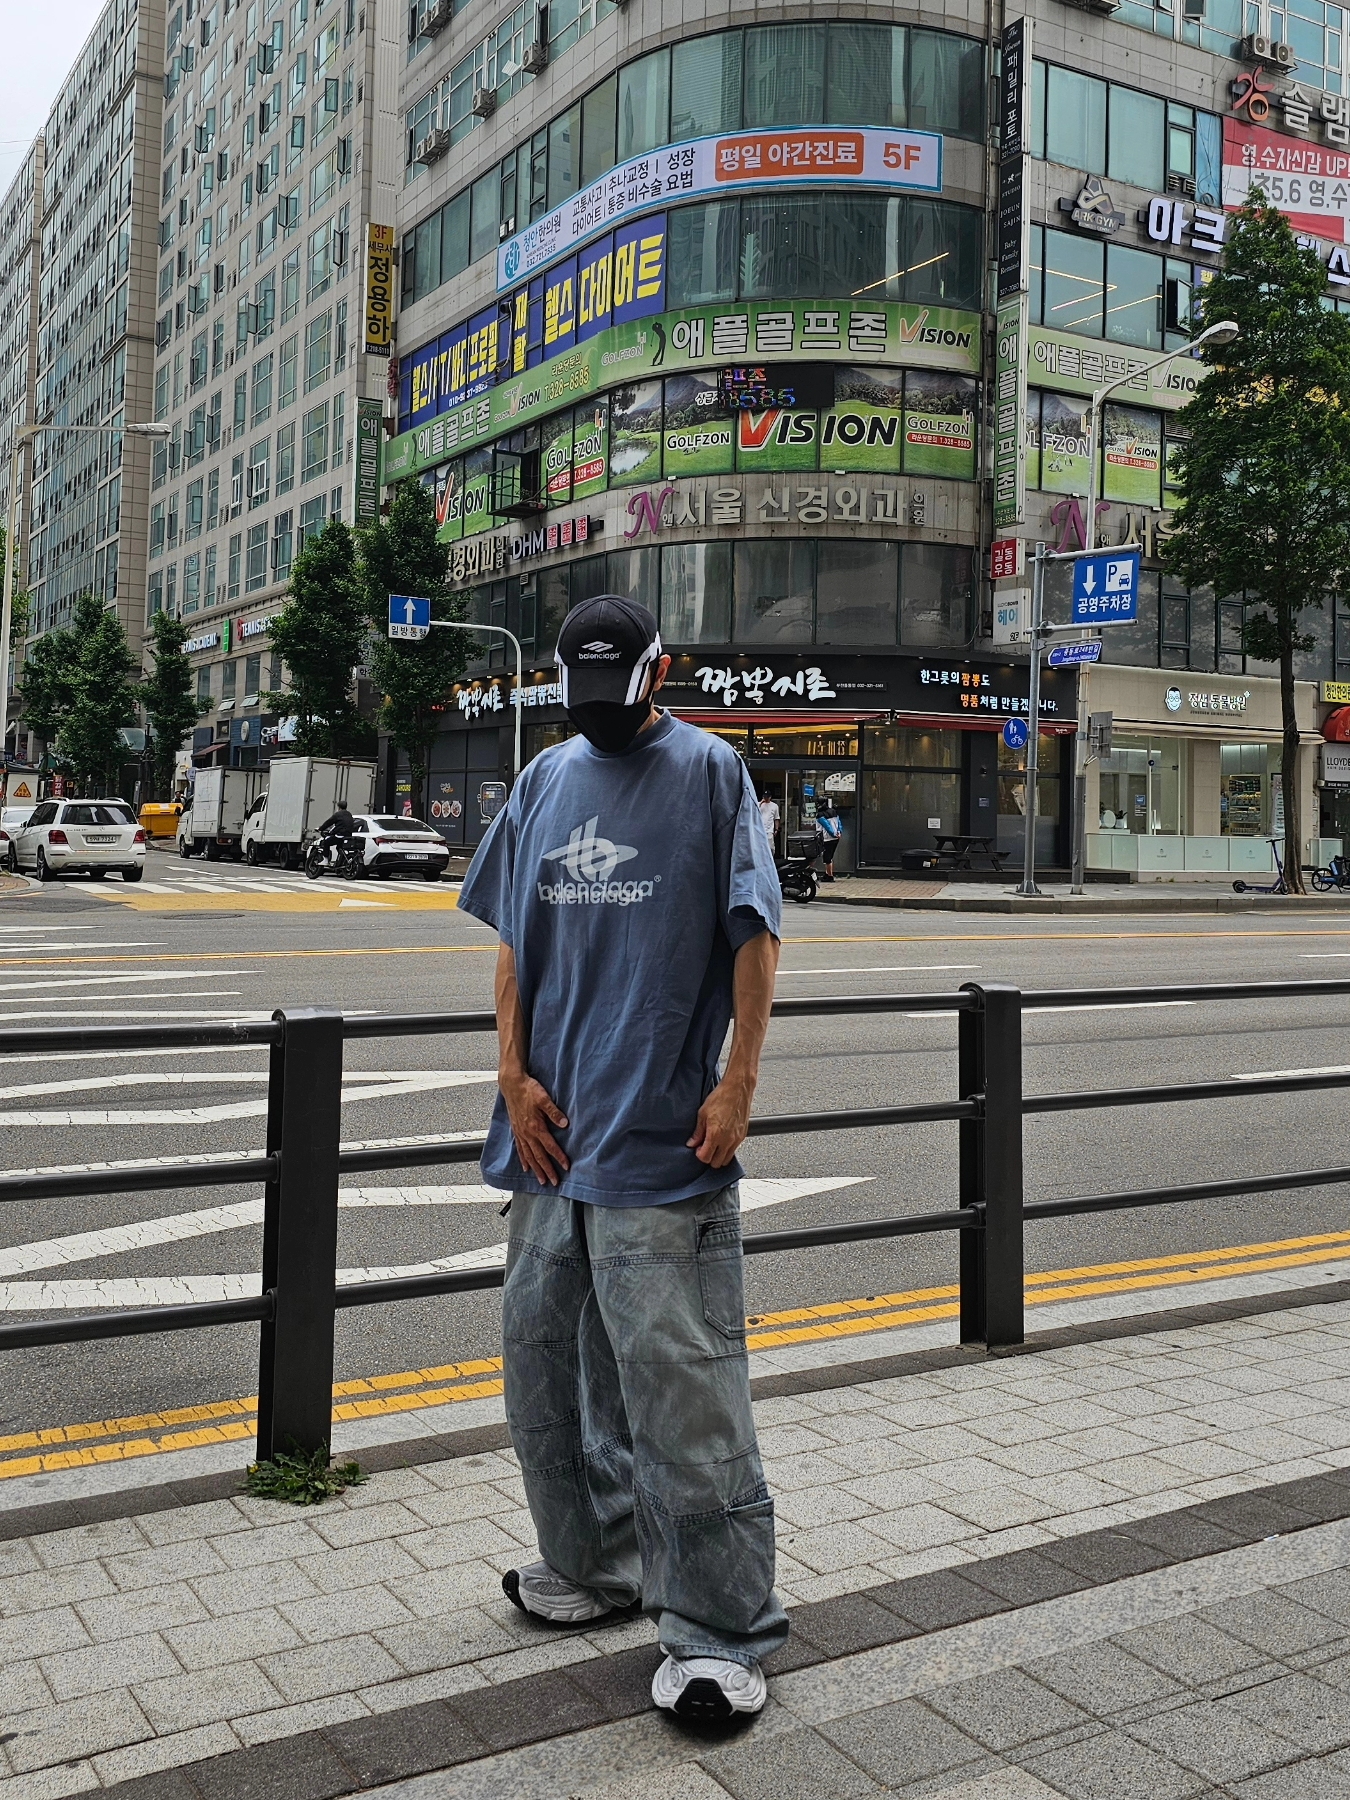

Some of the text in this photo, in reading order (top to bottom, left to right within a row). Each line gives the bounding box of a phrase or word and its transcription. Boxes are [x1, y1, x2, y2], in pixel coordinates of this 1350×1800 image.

[1005, 108, 1018, 140] 포토
[720, 140, 858, 171] 평일 야간진료
[883, 142, 921, 170] 5F
[572, 148, 696, 217] 교통사고 추나교정 성장
[1309, 179, 1350, 209] 영.수
[572, 169, 694, 236] 다이어트 통증 비수술 요법
[1000, 202, 1021, 218] JOEUN
[374, 225, 388, 240] 3F
[523, 211, 562, 252] 청안한의원
[1003, 215, 1021, 228] SAJIN
[1073, 209, 1117, 228] ARK GYM
[1149, 198, 1228, 253] 아크
[368, 241, 392, 256] 세무사
[1001, 250, 1019, 262] Family
[1004, 240, 1017, 250] Baby
[367, 256, 391, 343] 정용하
[544, 233, 664, 346] 헬스 다이어트
[672, 311, 887, 359] 애플골프존
[900, 309, 972, 348] VISION
[601, 345, 645, 366] GOLFZON
[1033, 341, 1149, 391] 애플골프존
[544, 366, 590, 404] T.328-8585
[1153, 359, 1200, 393] VISIO
[510, 382, 542, 419] VISION
[418, 397, 491, 461] 애플골프존
[739, 408, 899, 452] VISION
[907, 416, 970, 436] GOLFZON
[997, 332, 1018, 502] 애플골프존
[667, 431, 731, 451] GOLFZON
[1126, 436, 1158, 459] VISION
[358, 417, 379, 518] 애플골프존
[436, 471, 486, 528] VISION
[624, 487, 675, 538] N
[677, 488, 742, 527] 서울
[756, 486, 908, 527] 신경외과
[446, 537, 495, 583] 경외과
[512, 528, 544, 561] DHM
[995, 562, 1013, 576] 우동
[997, 607, 1018, 626] 헤어
[1077, 594, 1132, 614] 공영주차장
[391, 625, 427, 639] 일방통행
[1010, 631, 1020, 641] 2F
[578, 652, 620, 660] balenciaga
[695, 666, 837, 707] 짬뽕지존
[920, 669, 991, 688] 한그릇의 짬뽕도
[960, 693, 1059, 712] 명품처럼 만들겠니다.
[1210, 693, 1247, 711] 동물병원
